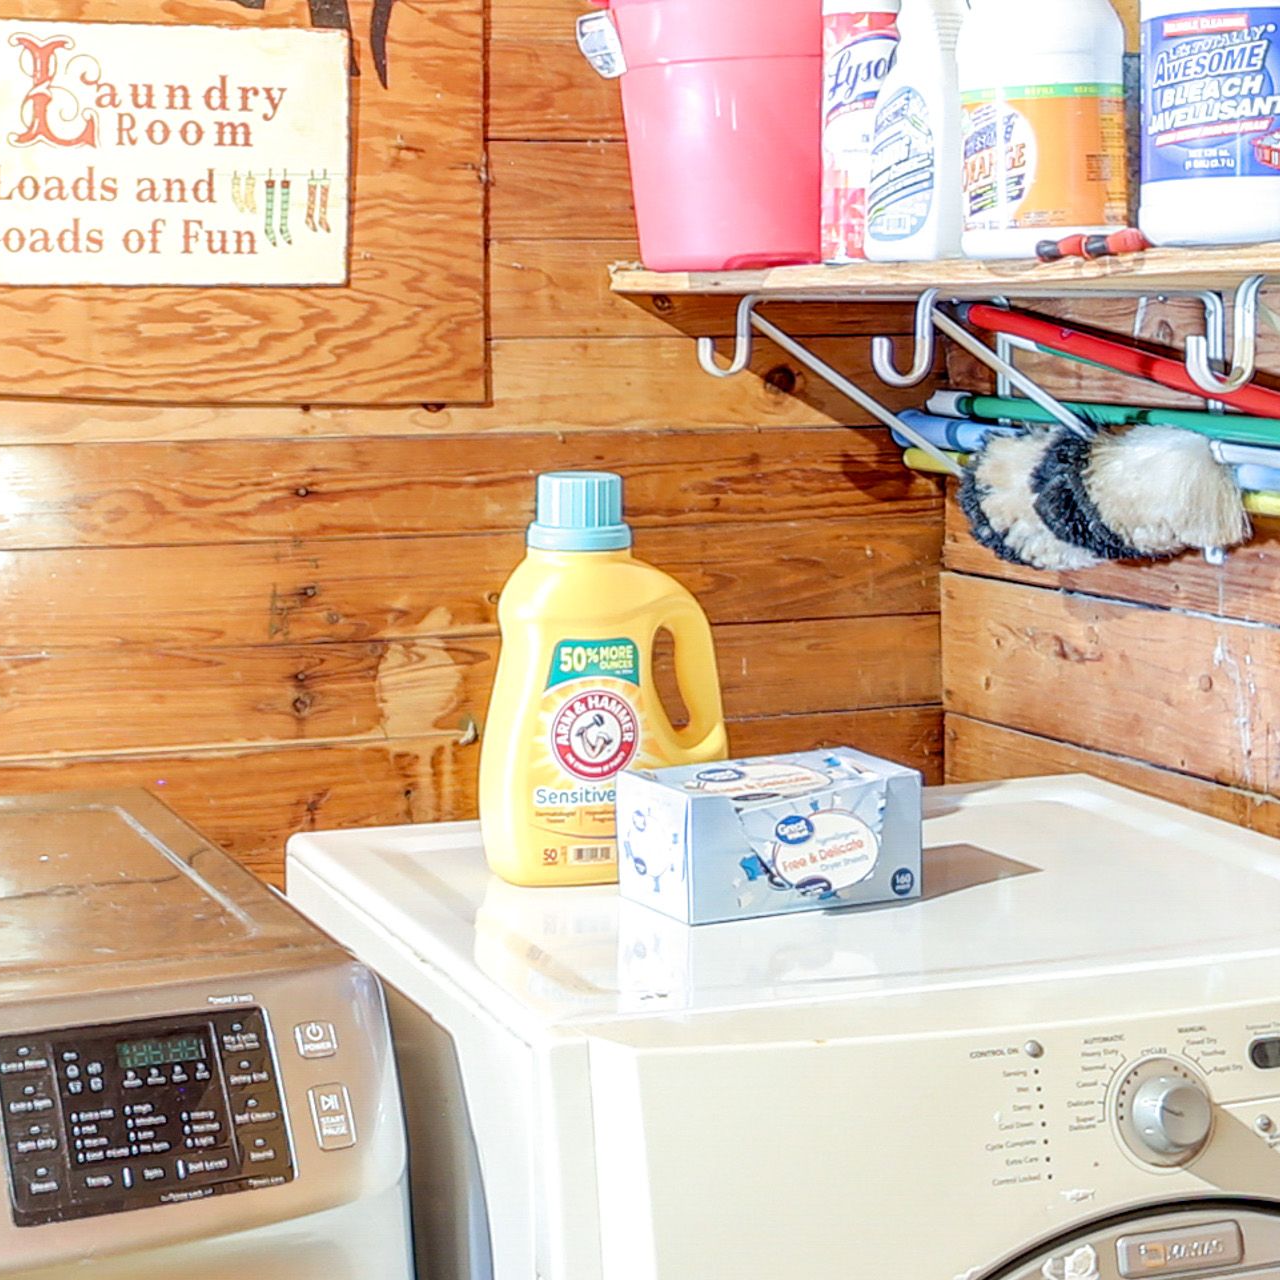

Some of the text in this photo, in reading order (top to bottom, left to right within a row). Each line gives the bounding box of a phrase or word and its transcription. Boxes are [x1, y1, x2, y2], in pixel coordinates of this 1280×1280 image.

[1192, 24, 1266, 56] TOTALLY
[1152, 39, 1270, 88] AWESOME
[7, 33, 288, 148] Laundry
[1160, 74, 1264, 109] BLEACH
[116, 112, 254, 148] Room
[135, 168, 218, 203] and
[122, 217, 166, 254] of
[181, 219, 258, 255] Fun
[559, 644, 634, 673] 50% MORE
[599, 660, 634, 671] OUNCES
[556, 694, 634, 746] ARM & HAMMER
[536, 787, 617, 804] Sensitive
[543, 848, 558, 862] 50
[782, 839, 865, 873] Free & Delicate
[304, 1041, 333, 1051] POWER
[969, 1047, 1019, 1059] CONTROL ON
[1140, 1047, 1168, 1057] CYCLES
[320, 1114, 345, 1125] START
[321, 1125, 349, 1137] PAUSE
[1004, 1138, 1037, 1149] Complete
[992, 1177, 1017, 1186] Control
